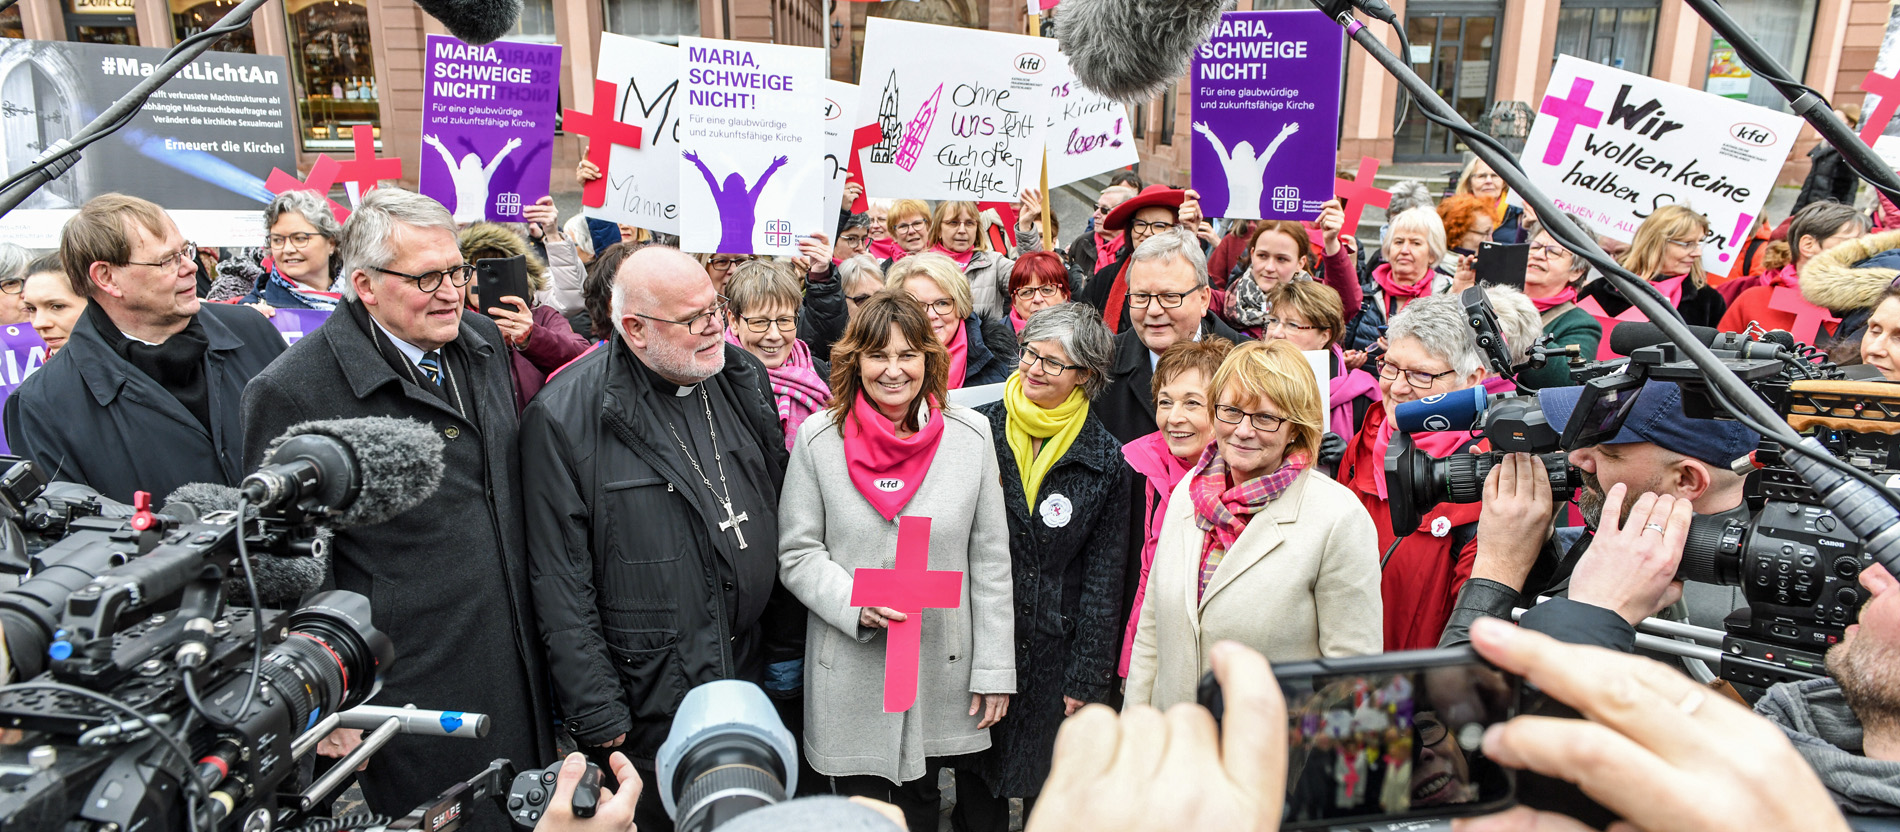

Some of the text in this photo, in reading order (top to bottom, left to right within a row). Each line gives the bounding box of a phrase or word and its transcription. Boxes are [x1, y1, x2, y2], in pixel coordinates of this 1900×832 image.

[435, 42, 502, 65] MARIA,
[689, 46, 760, 70] MARIA,
[1200, 41, 1308, 59] SCHWEIGE
[102, 56, 279, 84] #MatLichtAn
[433, 62, 532, 84] SCHWEIGE
[1019, 57, 1040, 71] kfd
[1200, 63, 1267, 80] NICHT!
[689, 68, 794, 91] SCHWEIGE
[168, 91, 208, 101] verkrustete
[210, 93, 267, 104] Machtstrukturen
[268, 96, 280, 105] ab!
[433, 81, 496, 100] NICHT!
[1051, 81, 1070, 97] ns
[1200, 87, 1299, 98] Für eine glaubwürdige
[689, 89, 755, 110] NICHT!
[1200, 100, 1315, 111] und zukunftsfähige Kirche
[142, 102, 282, 117] abhängige Missbrauchsbeauftragte ein!
[432, 102, 523, 118] Für eine glaubwürdige
[1606, 83, 1684, 141] Wir
[153, 115, 283, 129] Verändert die kirchliche Sexualmoral!
[431, 115, 536, 128] und zukunftsfähige Kirche
[689, 114, 787, 130] Für eine glaubwürdige
[689, 128, 803, 143] und zukunftsfähige Kirche
[1737, 126, 1769, 144] kfd
[164, 138, 285, 154] Erneuert die Kirche!
[933, 143, 978, 167] Euch
[1561, 160, 1640, 204] halben
[1671, 159, 1750, 204] keine
[605, 171, 680, 220] Männe
[1553, 199, 1640, 235] FRAUEN IN ALL
[0, 346, 46, 386] IA
[880, 480, 898, 488] kfd
[1818, 538, 1845, 548] Canon
